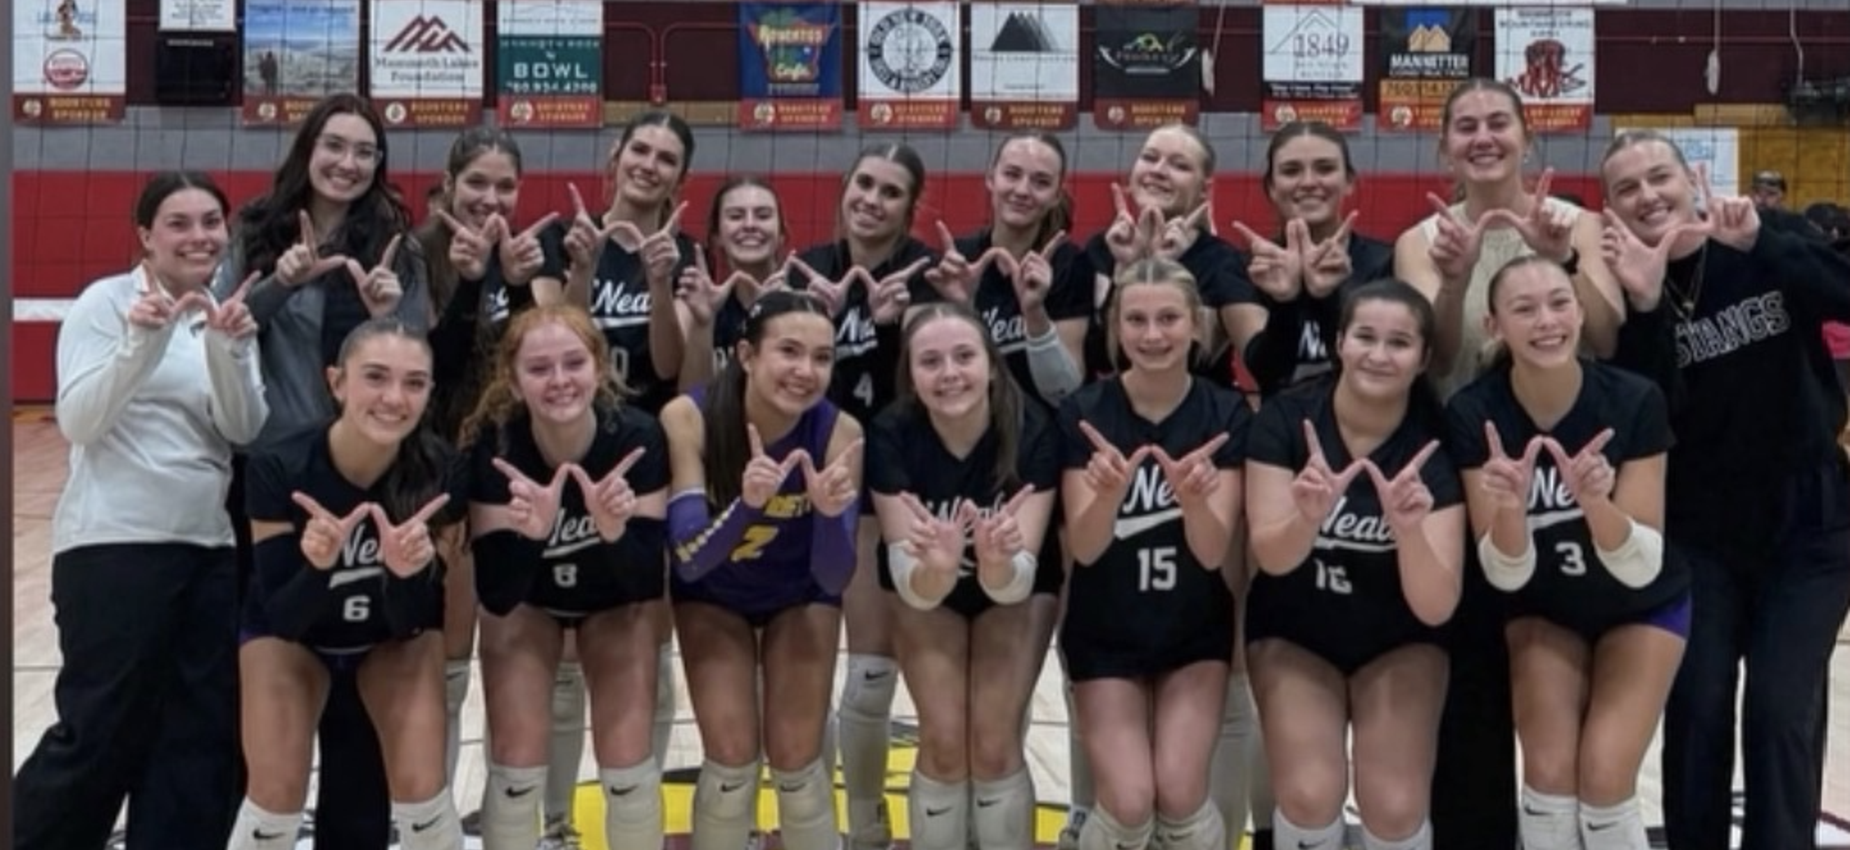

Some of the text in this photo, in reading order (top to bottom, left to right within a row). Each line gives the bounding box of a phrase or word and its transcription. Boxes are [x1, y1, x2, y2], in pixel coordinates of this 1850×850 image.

[375, 57, 479, 68] Mammoth Lakes
[1294, 33, 1350, 57] 1849
[1391, 53, 1469, 69] MANNETTER
[391, 71, 465, 82] Foundation
[513, 62, 588, 79] BOWL
[590, 279, 652, 314] 'Nea
[1298, 320, 1328, 360] N
[1676, 290, 1790, 368] STANGS
[853, 371, 874, 408] 4
[1122, 464, 1179, 513] Ne
[1528, 466, 1576, 509] Ne
[343, 522, 379, 568] Ne
[731, 525, 778, 562] 2
[1556, 542, 1586, 576] 3
[1138, 547, 1177, 592] 15
[343, 595, 371, 622] 6
